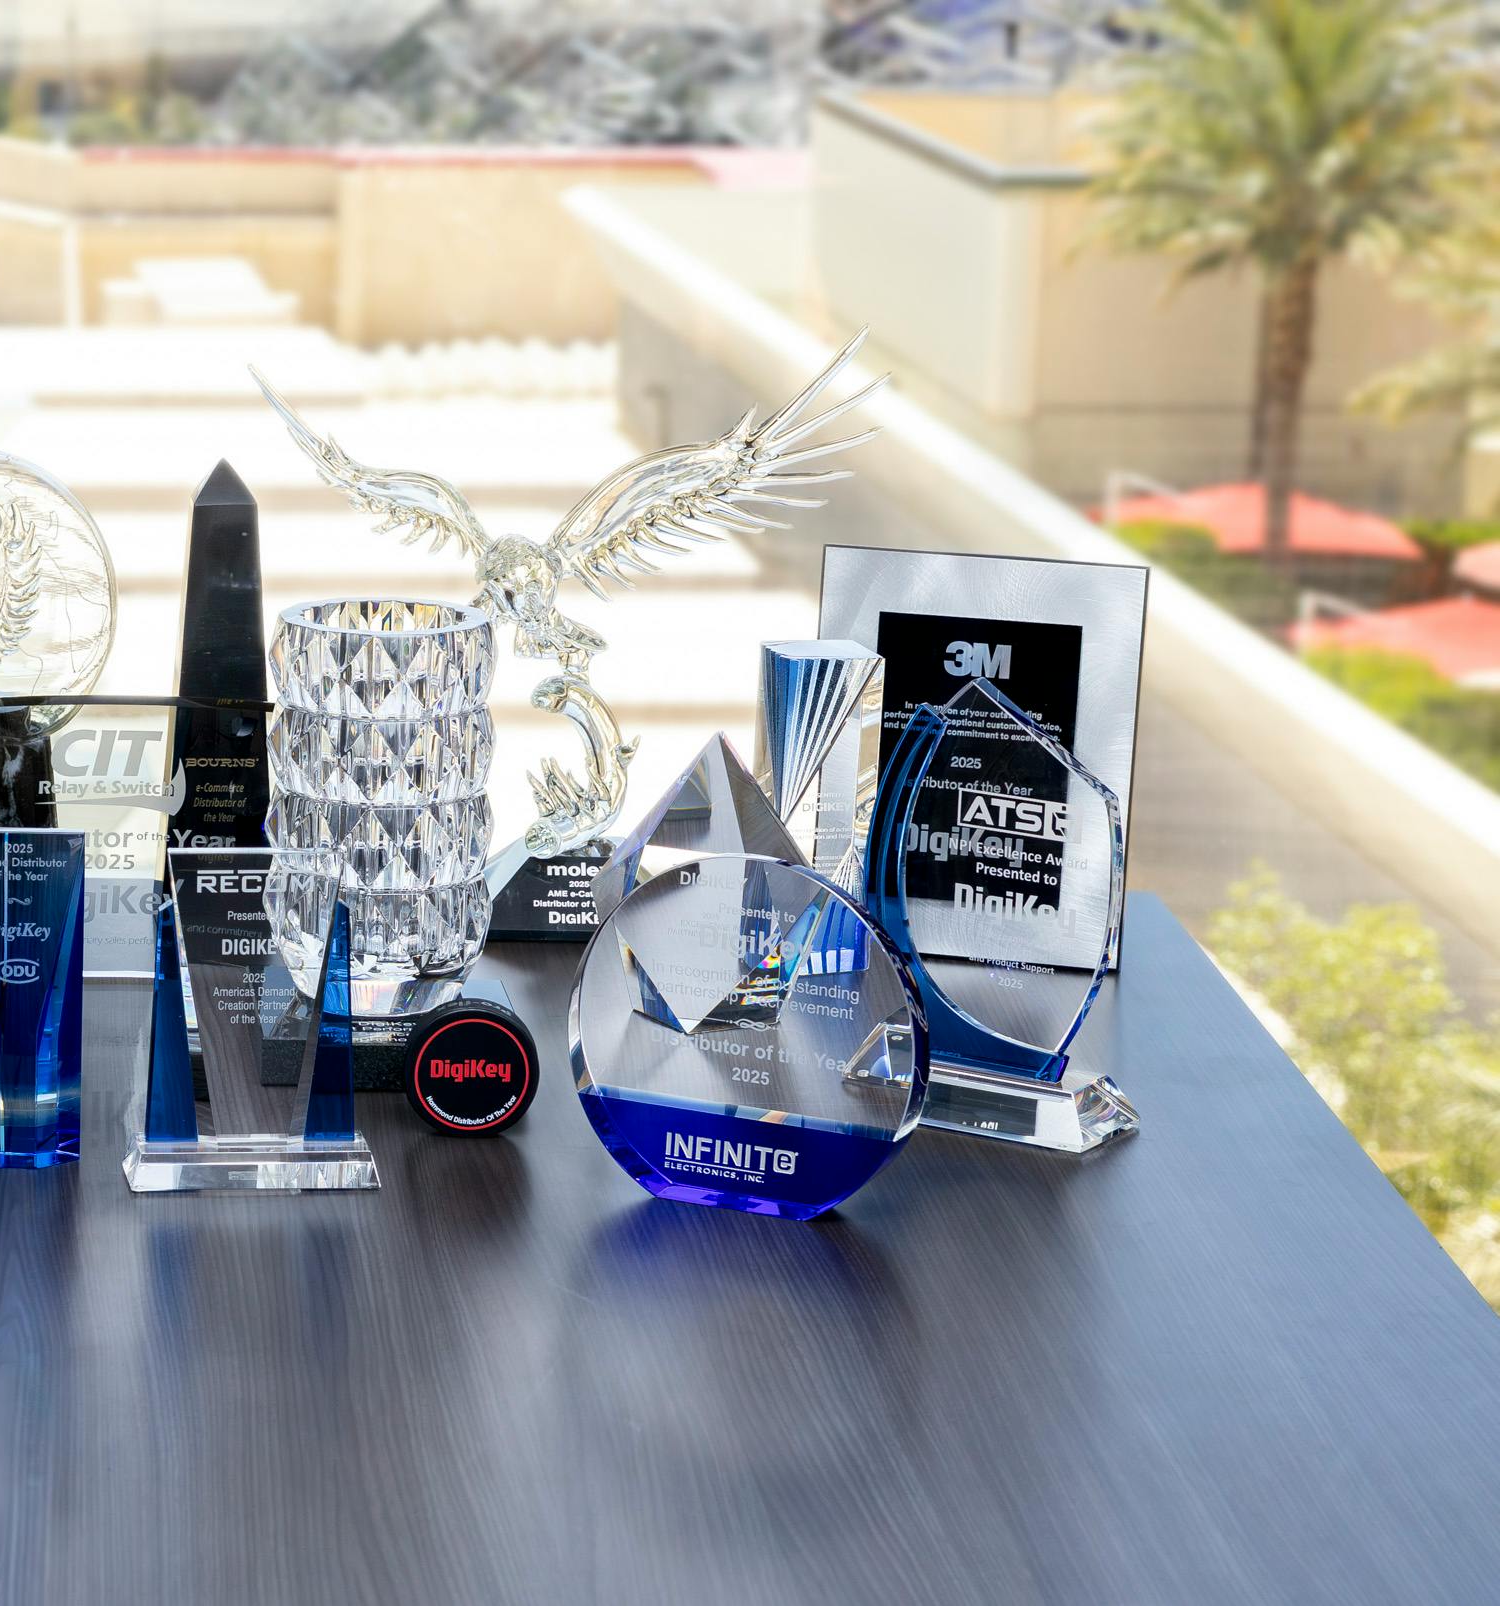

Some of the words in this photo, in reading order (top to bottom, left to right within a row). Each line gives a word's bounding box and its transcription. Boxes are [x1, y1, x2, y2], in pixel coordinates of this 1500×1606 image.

[943, 640, 1012, 680] 3M
[959, 708, 969, 716] of
[969, 710, 988, 718] your
[883, 721, 899, 729] and
[947, 729, 999, 741] commitment
[1000, 732, 1009, 741] to
[53, 728, 164, 777] CIT
[950, 756, 982, 770] 2025
[38, 780, 87, 798] Relay
[92, 781, 106, 796] &
[111, 779, 176, 797] Switch
[1005, 782, 1034, 797] Year
[193, 797, 236, 808] Distributor
[203, 813, 217, 823] the
[218, 813, 237, 823] Year
[136, 831, 150, 842] of
[152, 832, 171, 843] the
[173, 828, 237, 849] Year
[5, 843, 33, 854] 2025
[949, 836, 972, 853] NPI
[976, 841, 1042, 863] Excellence
[12, 857, 67, 868] Distributor
[25, 871, 49, 881] Year
[975, 861, 1040, 884] Presented
[1043, 872, 1058, 886] to
[569, 880, 590, 888] 2025
[548, 890, 568, 898] AME
[533, 900, 579, 908] Distributor
[581, 899, 590, 908] of
[953, 881, 1077, 937] DigiKey
[784, 911, 797, 923] to
[987, 957, 1019, 969] Product
[1020, 962, 1055, 976] Support
[242, 973, 266, 983] 2025
[998, 977, 1024, 989] 2025
[213, 987, 255, 997] Americas
[258, 987, 295, 997] Demand
[218, 1001, 255, 1011] Creation
[257, 1001, 290, 1010] Partner
[230, 1014, 242, 1024] of
[243, 1014, 256, 1024] the
[651, 1027, 747, 1057] Distributor
[753, 1045, 776, 1062] of
[779, 1047, 809, 1065] the
[430, 1059, 512, 1082] DigiKey
[731, 1066, 771, 1086] 2025
[425, 1095, 453, 1121] Hammond
[453, 1114, 486, 1126] Distributor
[493, 1106, 507, 1119] The
[503, 1095, 518, 1112] Year
[664, 1161, 741, 1182] ELECTRONICS,
[743, 1172, 765, 1184] INC.
